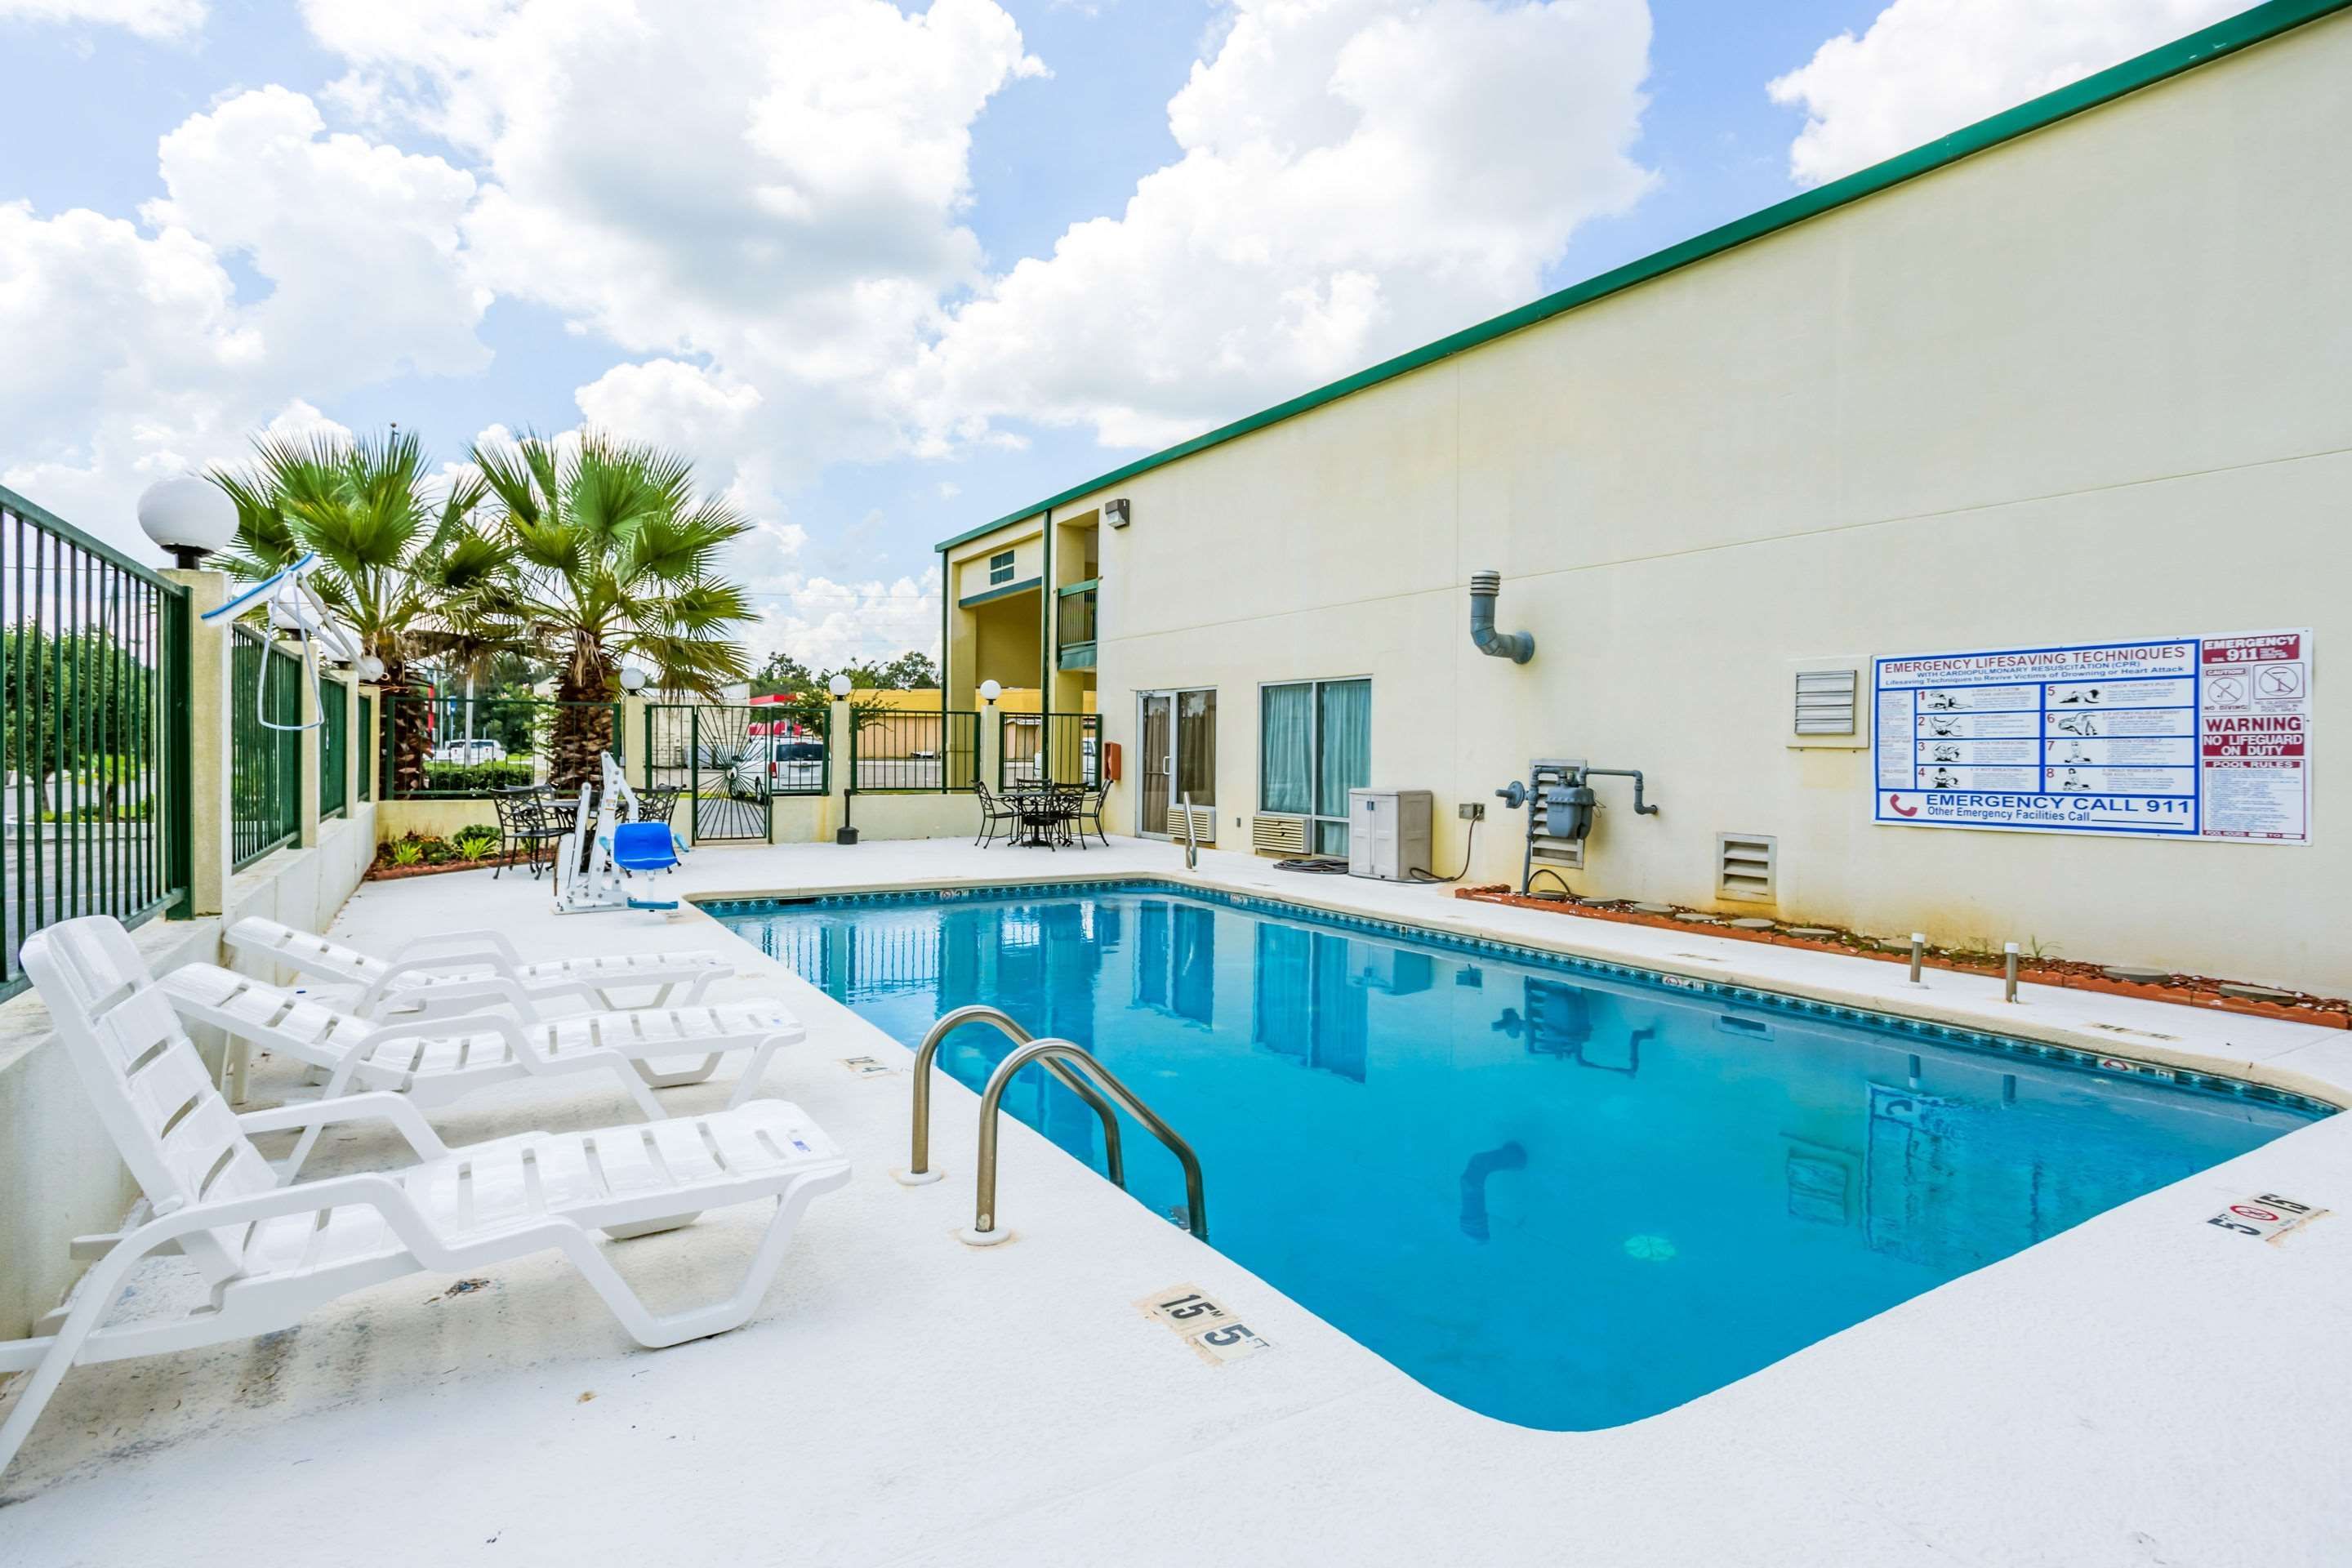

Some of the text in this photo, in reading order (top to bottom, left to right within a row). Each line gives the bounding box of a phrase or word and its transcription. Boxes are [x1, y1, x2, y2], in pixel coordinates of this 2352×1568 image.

[2204, 635, 2297, 650] EMERGENCY
[1885, 646, 2185, 674] EMERGENCY LIFESAVING TECHNIQUES
[2226, 648, 2259, 662] 911
[1940, 666, 2028, 676] CARDIOPULMONARY
[2031, 662, 2109, 671] RESUSCITATION
[2111, 660, 2140, 669] (CPR)
[1886, 677, 1924, 686] Lifesaving
[1927, 675, 1972, 684] Techniques
[2061, 670, 2106, 678] Drowning
[1918, 691, 1925, 701] 1
[2047, 685, 2056, 696] 5
[1918, 716, 1925, 726] 2
[2047, 713, 2055, 723] 6
[2205, 716, 2301, 733] WARNING
[2047, 740, 2055, 751] 7
[2203, 734, 2303, 746] NO LIFEGUARD
[1918, 742, 1925, 751] 3
[2221, 746, 2284, 755] ON DUTY
[1918, 768, 1926, 777] 4
[2047, 768, 2055, 777] 8
[1927, 794, 2189, 813] EMERGENCY CALL 911
[1927, 806, 2090, 822] Other Emergency Facilities Call
